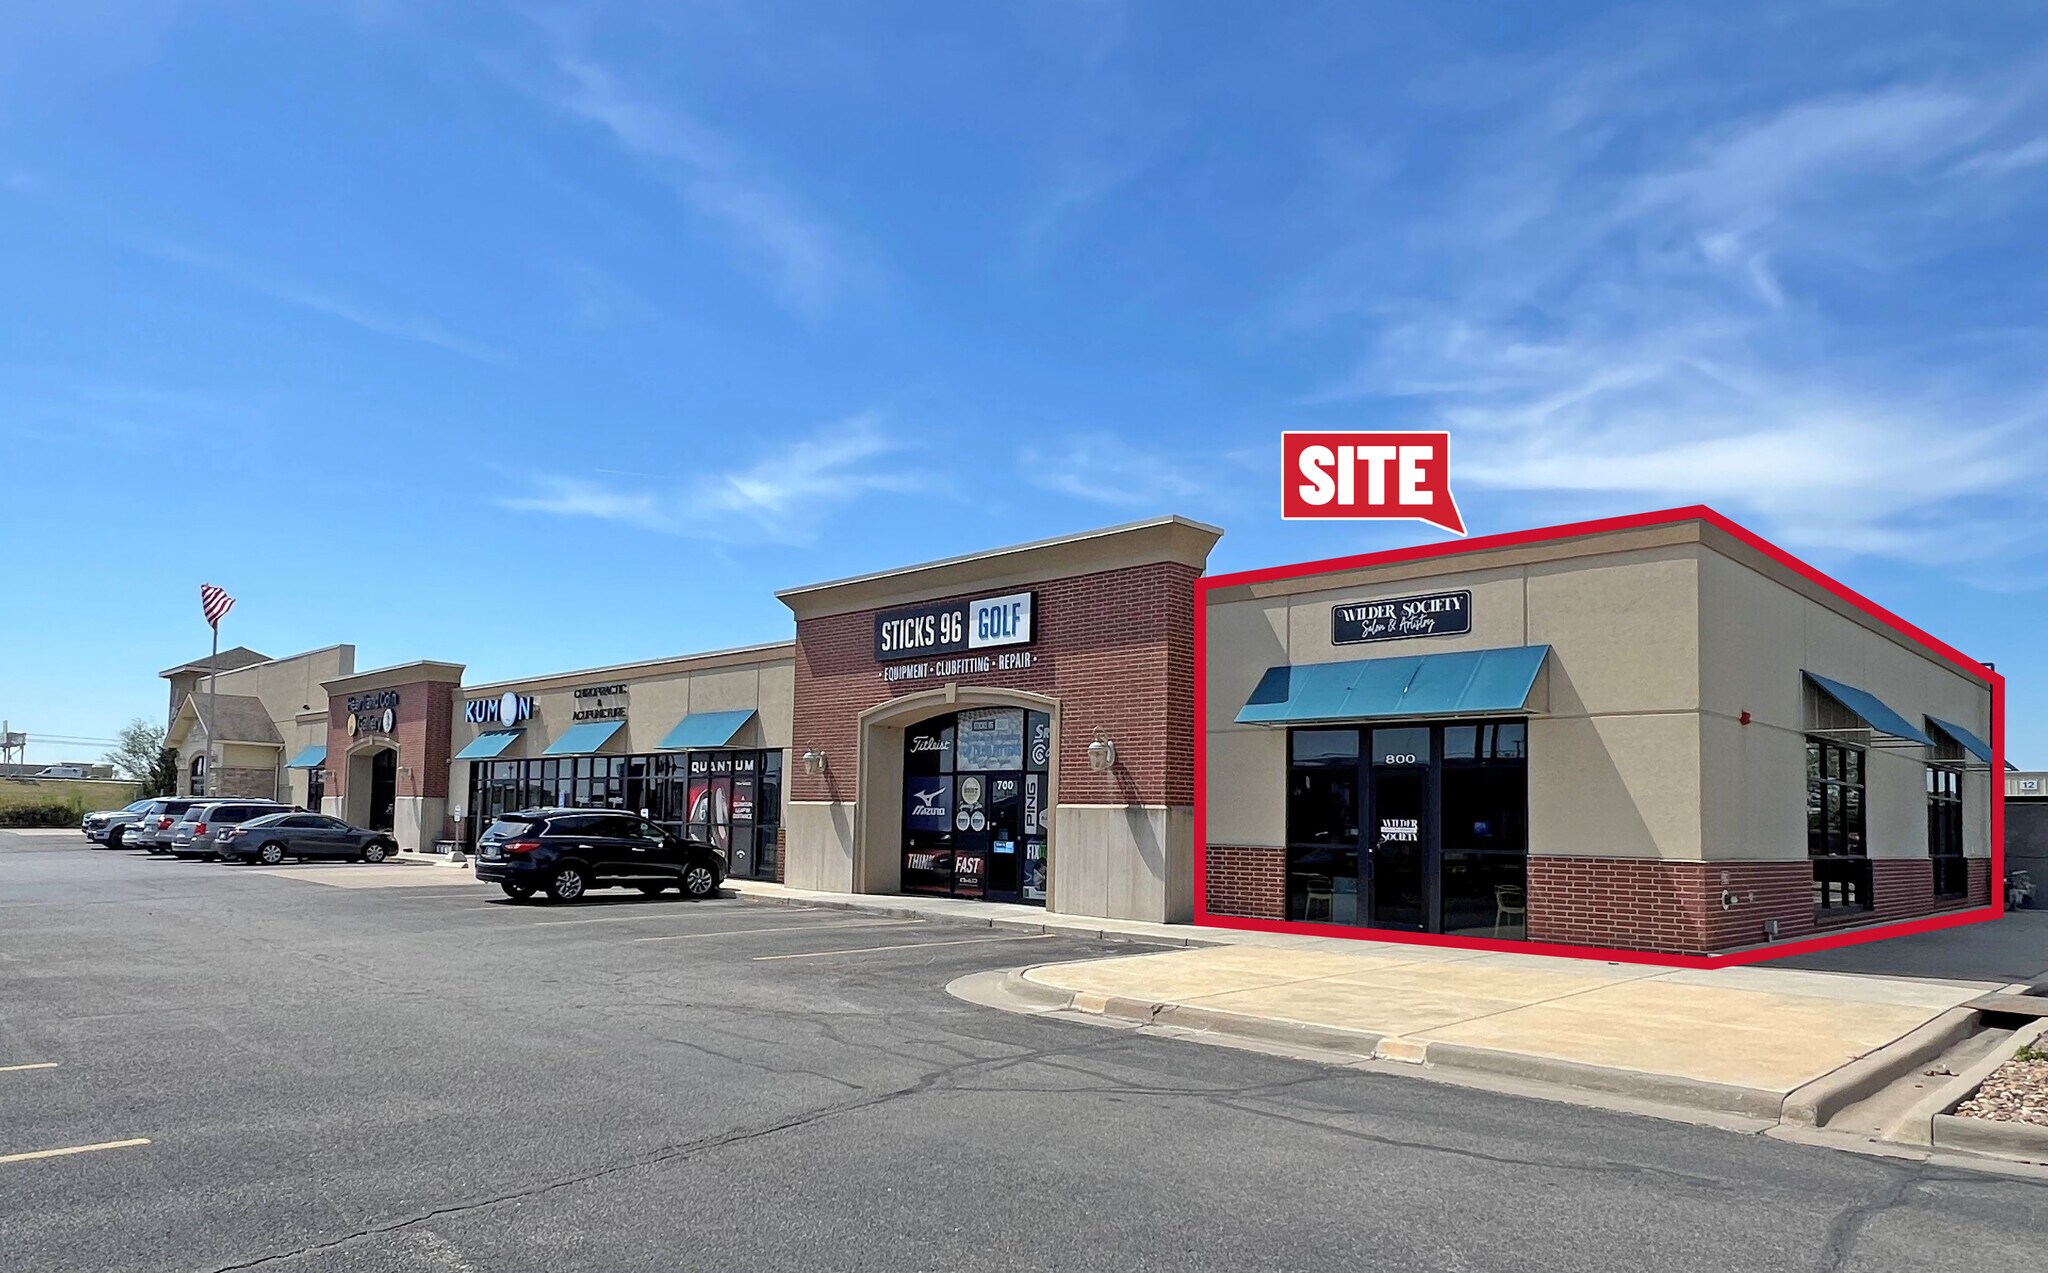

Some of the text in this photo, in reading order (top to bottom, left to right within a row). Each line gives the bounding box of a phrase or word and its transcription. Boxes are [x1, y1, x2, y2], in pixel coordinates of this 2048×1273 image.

[1338, 597, 1461, 622] WILDER SOCIETY
[881, 602, 1021, 652] STICKS 96 GOLF
[1361, 619, 1385, 638] Salon
[1399, 613, 1435, 634] Artistry
[884, 652, 1031, 682] EQUIPMENT CLUBFITTING REPAIR
[465, 691, 531, 727] KUMON
[910, 735, 951, 753] Titleist
[691, 760, 754, 773] QUANTUM
[1385, 754, 1416, 764] 800
[996, 780, 1014, 790] 700
[2022, 781, 2035, 789] 12
[1026, 782, 1036, 827] PING
[1382, 818, 1418, 829] WILDER
[1380, 833, 1418, 843] SOCIETY
[955, 856, 981, 874] FAST
